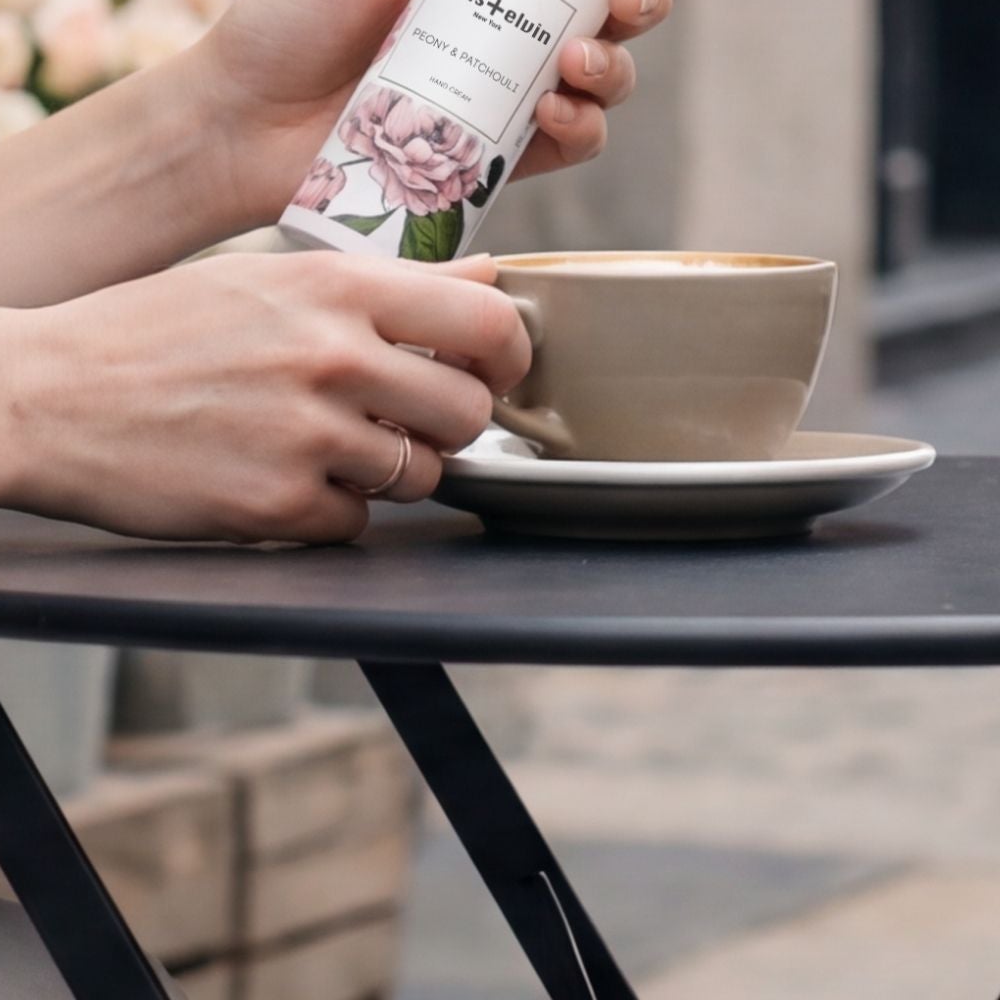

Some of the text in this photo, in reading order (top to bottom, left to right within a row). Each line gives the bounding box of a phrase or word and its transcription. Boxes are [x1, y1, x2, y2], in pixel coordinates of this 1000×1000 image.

[473, 11, 502, 31] New York
[412, 27, 520, 93] PEONY & PATCHOULI
[429, 76, 472, 102] HAND CREAM
